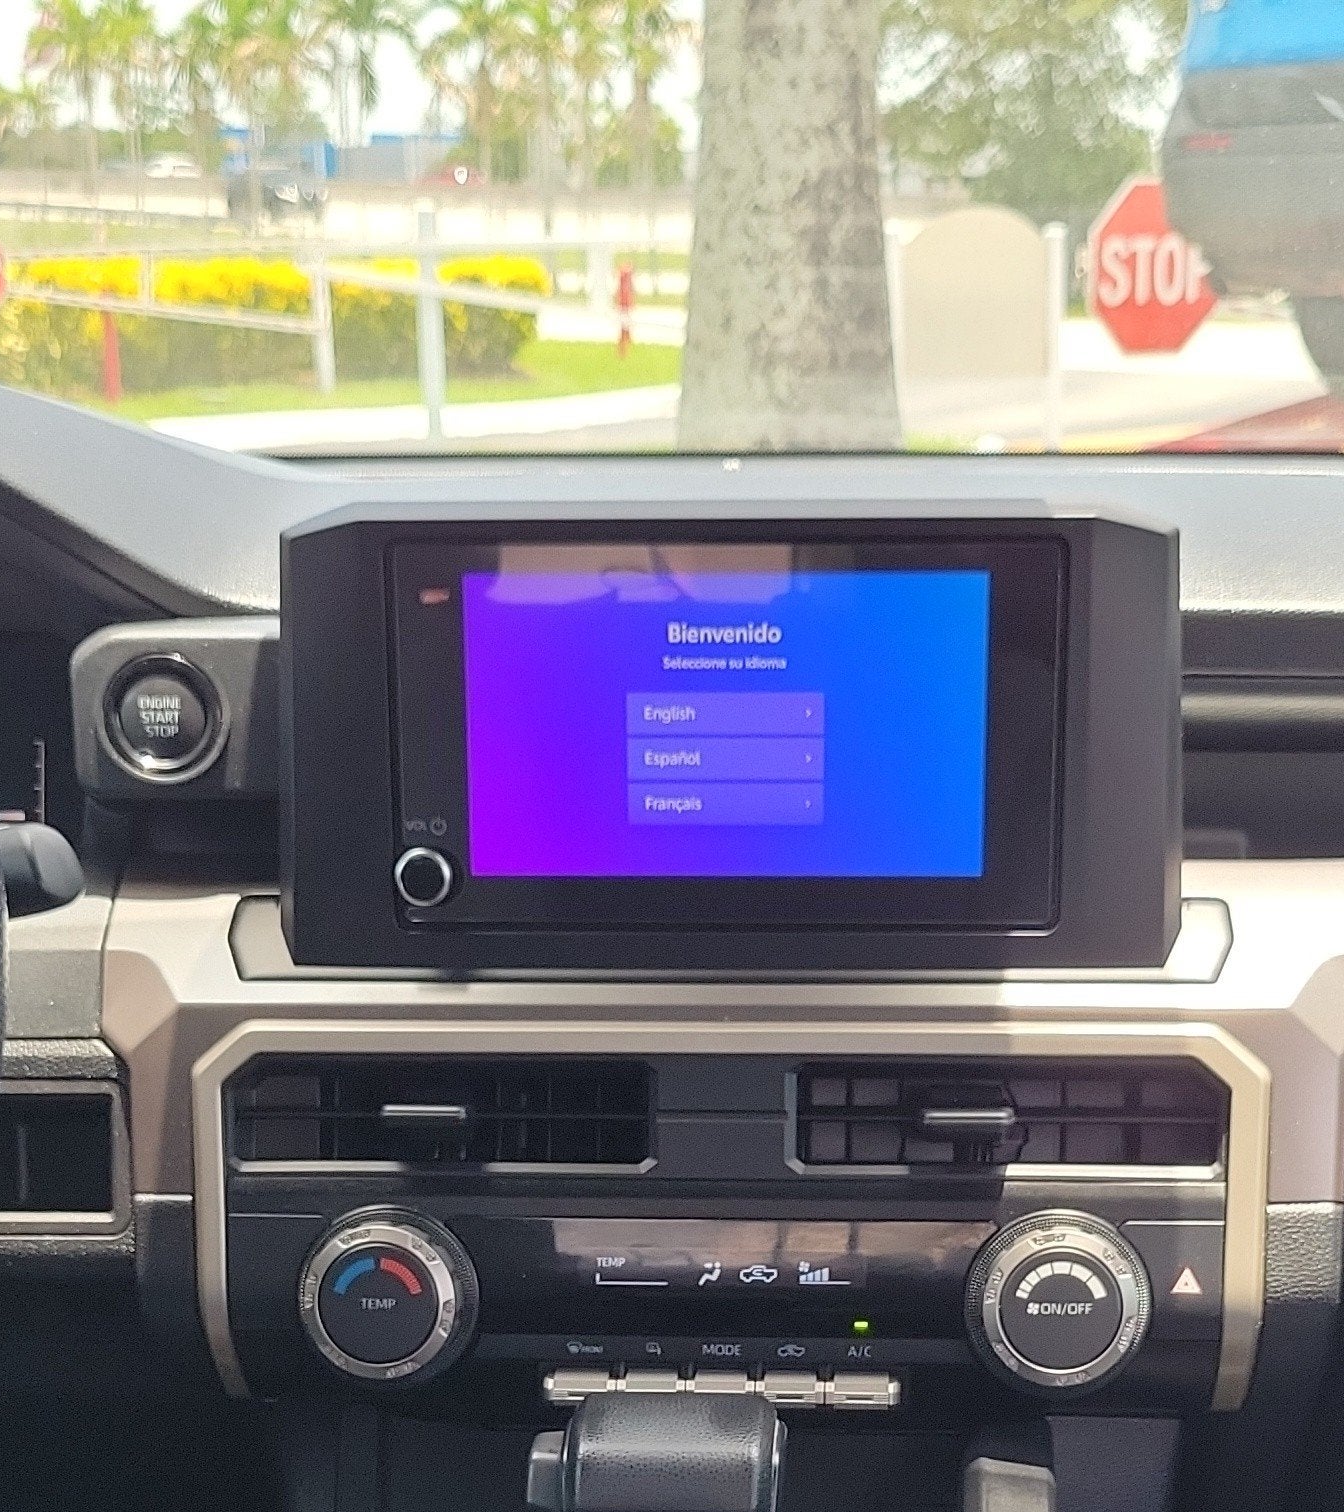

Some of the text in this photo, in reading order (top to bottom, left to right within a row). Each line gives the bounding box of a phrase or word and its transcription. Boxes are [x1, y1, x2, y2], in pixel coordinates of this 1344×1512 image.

[667, 621, 782, 644] Bienvenido
[662, 656, 727, 669] Seleccione
[137, 695, 181, 709] ENGINE
[140, 710, 179, 723] START
[644, 706, 696, 724] English
[145, 725, 179, 738] STOP
[644, 751, 701, 768] Español
[645, 796, 702, 813] Français
[596, 1257, 626, 1267] TEMP
[360, 1298, 397, 1310] TEMP
[1040, 1302, 1093, 1315] ON/OFF
[702, 1344, 742, 1356] MODE
[847, 1345, 872, 1357] A/C
